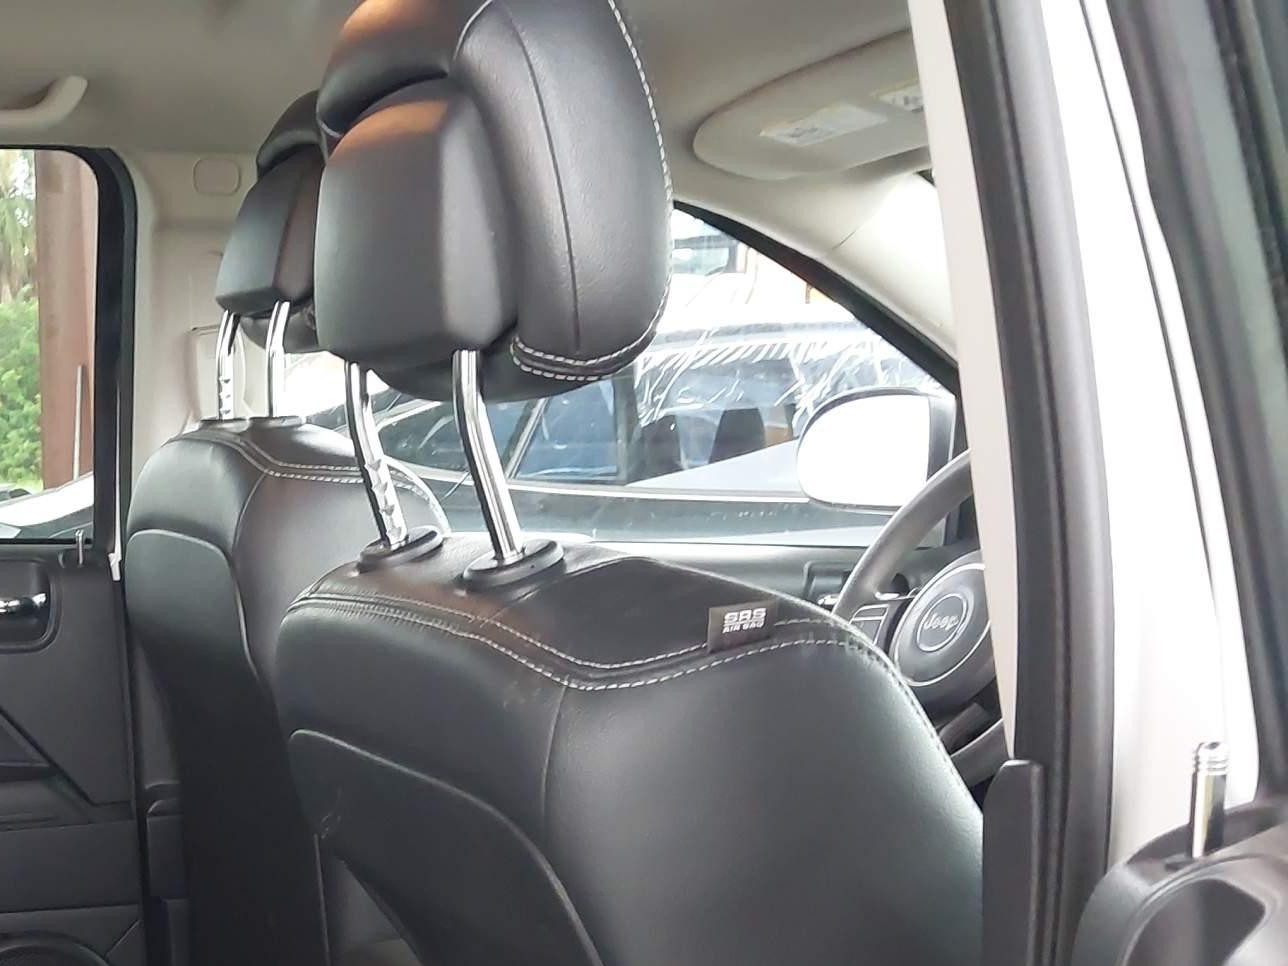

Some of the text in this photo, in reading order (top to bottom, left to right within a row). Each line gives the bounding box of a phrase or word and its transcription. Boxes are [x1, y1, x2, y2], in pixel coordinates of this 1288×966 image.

[724, 607, 767, 623] SRS
[923, 612, 960, 631] Jeep
[722, 622, 741, 634] AIR
